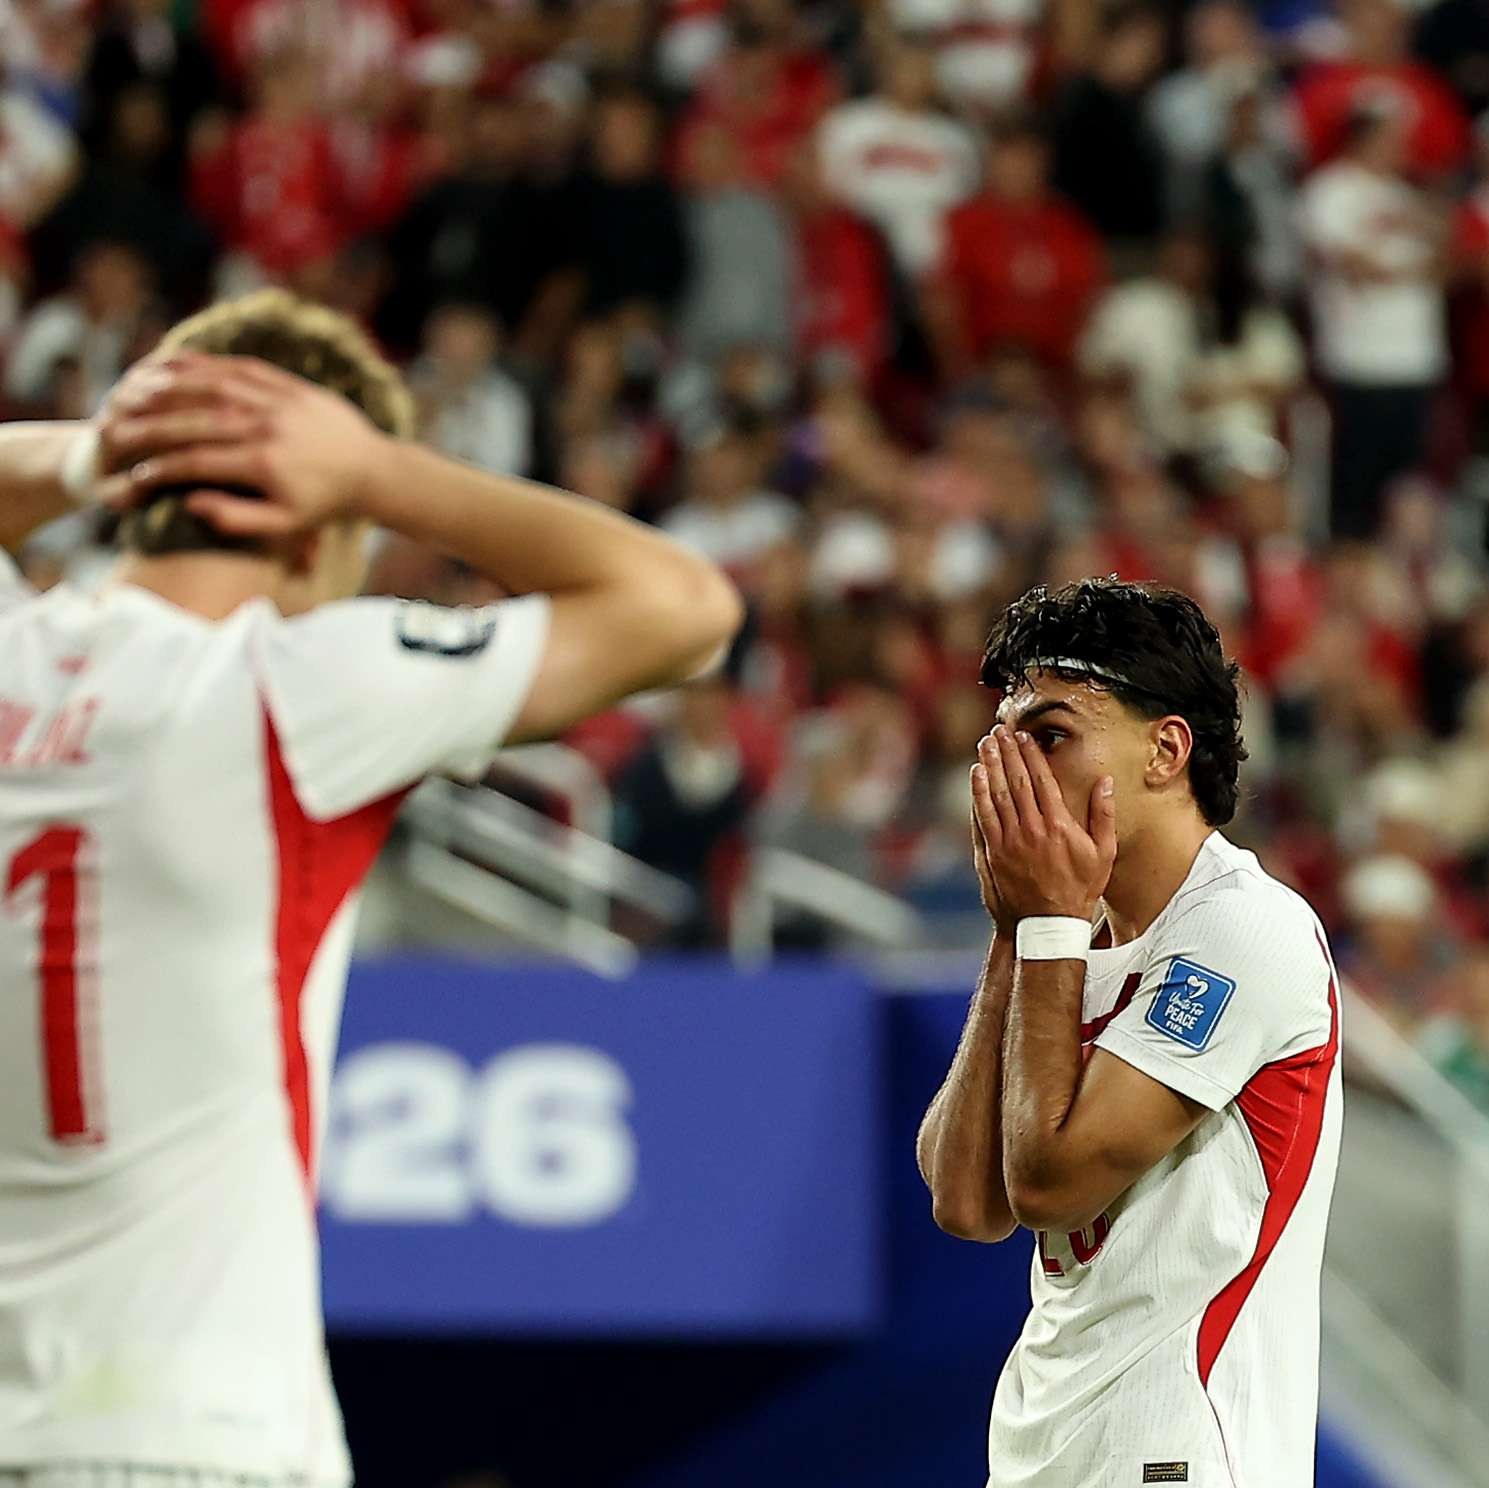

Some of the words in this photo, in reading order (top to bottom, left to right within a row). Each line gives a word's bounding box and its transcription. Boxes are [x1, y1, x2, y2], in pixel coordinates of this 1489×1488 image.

[1164, 1004, 1199, 1031] PEACE
[1165, 1020, 1184, 1035] FIFA
[322, 1038, 640, 1230] 26
